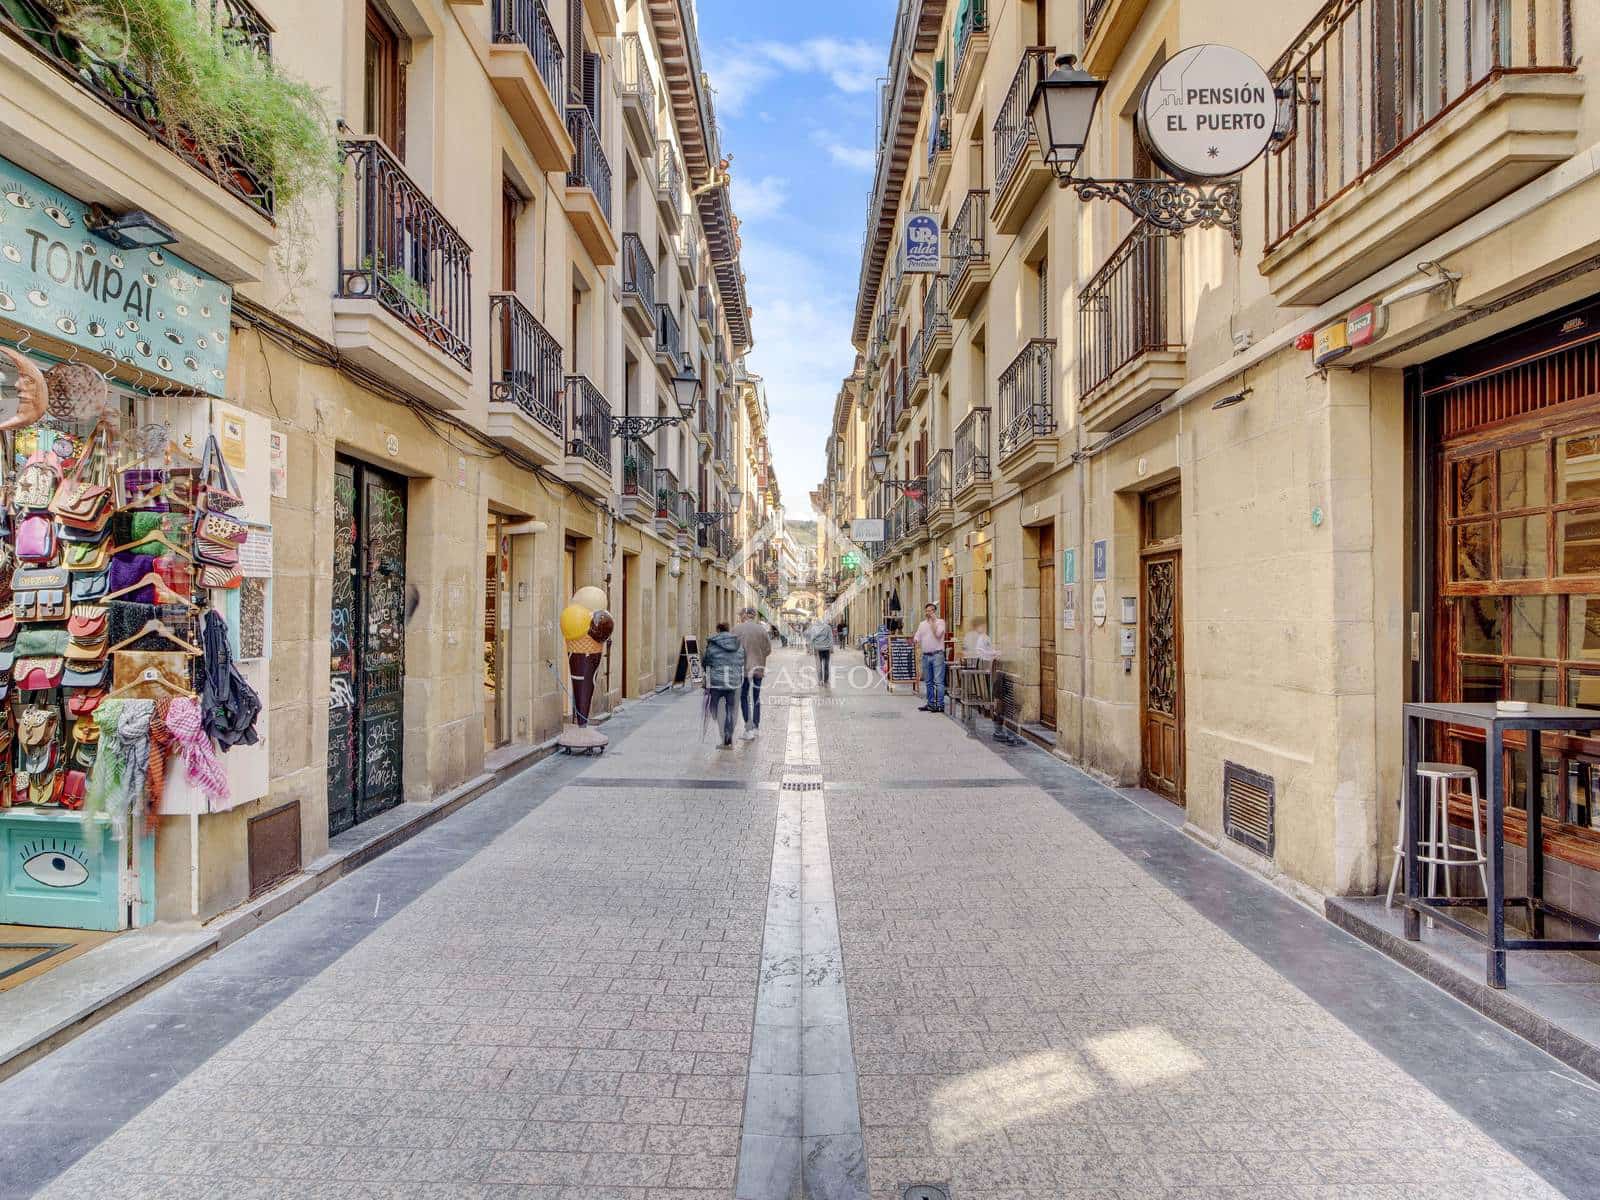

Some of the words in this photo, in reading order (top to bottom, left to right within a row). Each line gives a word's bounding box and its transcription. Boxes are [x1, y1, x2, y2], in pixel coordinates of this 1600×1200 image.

[1187, 82, 1265, 105] PENSIÓN
[1167, 115, 1188, 131] EL
[1196, 113, 1265, 131] PUERTO
[911, 243, 936, 254] alde
